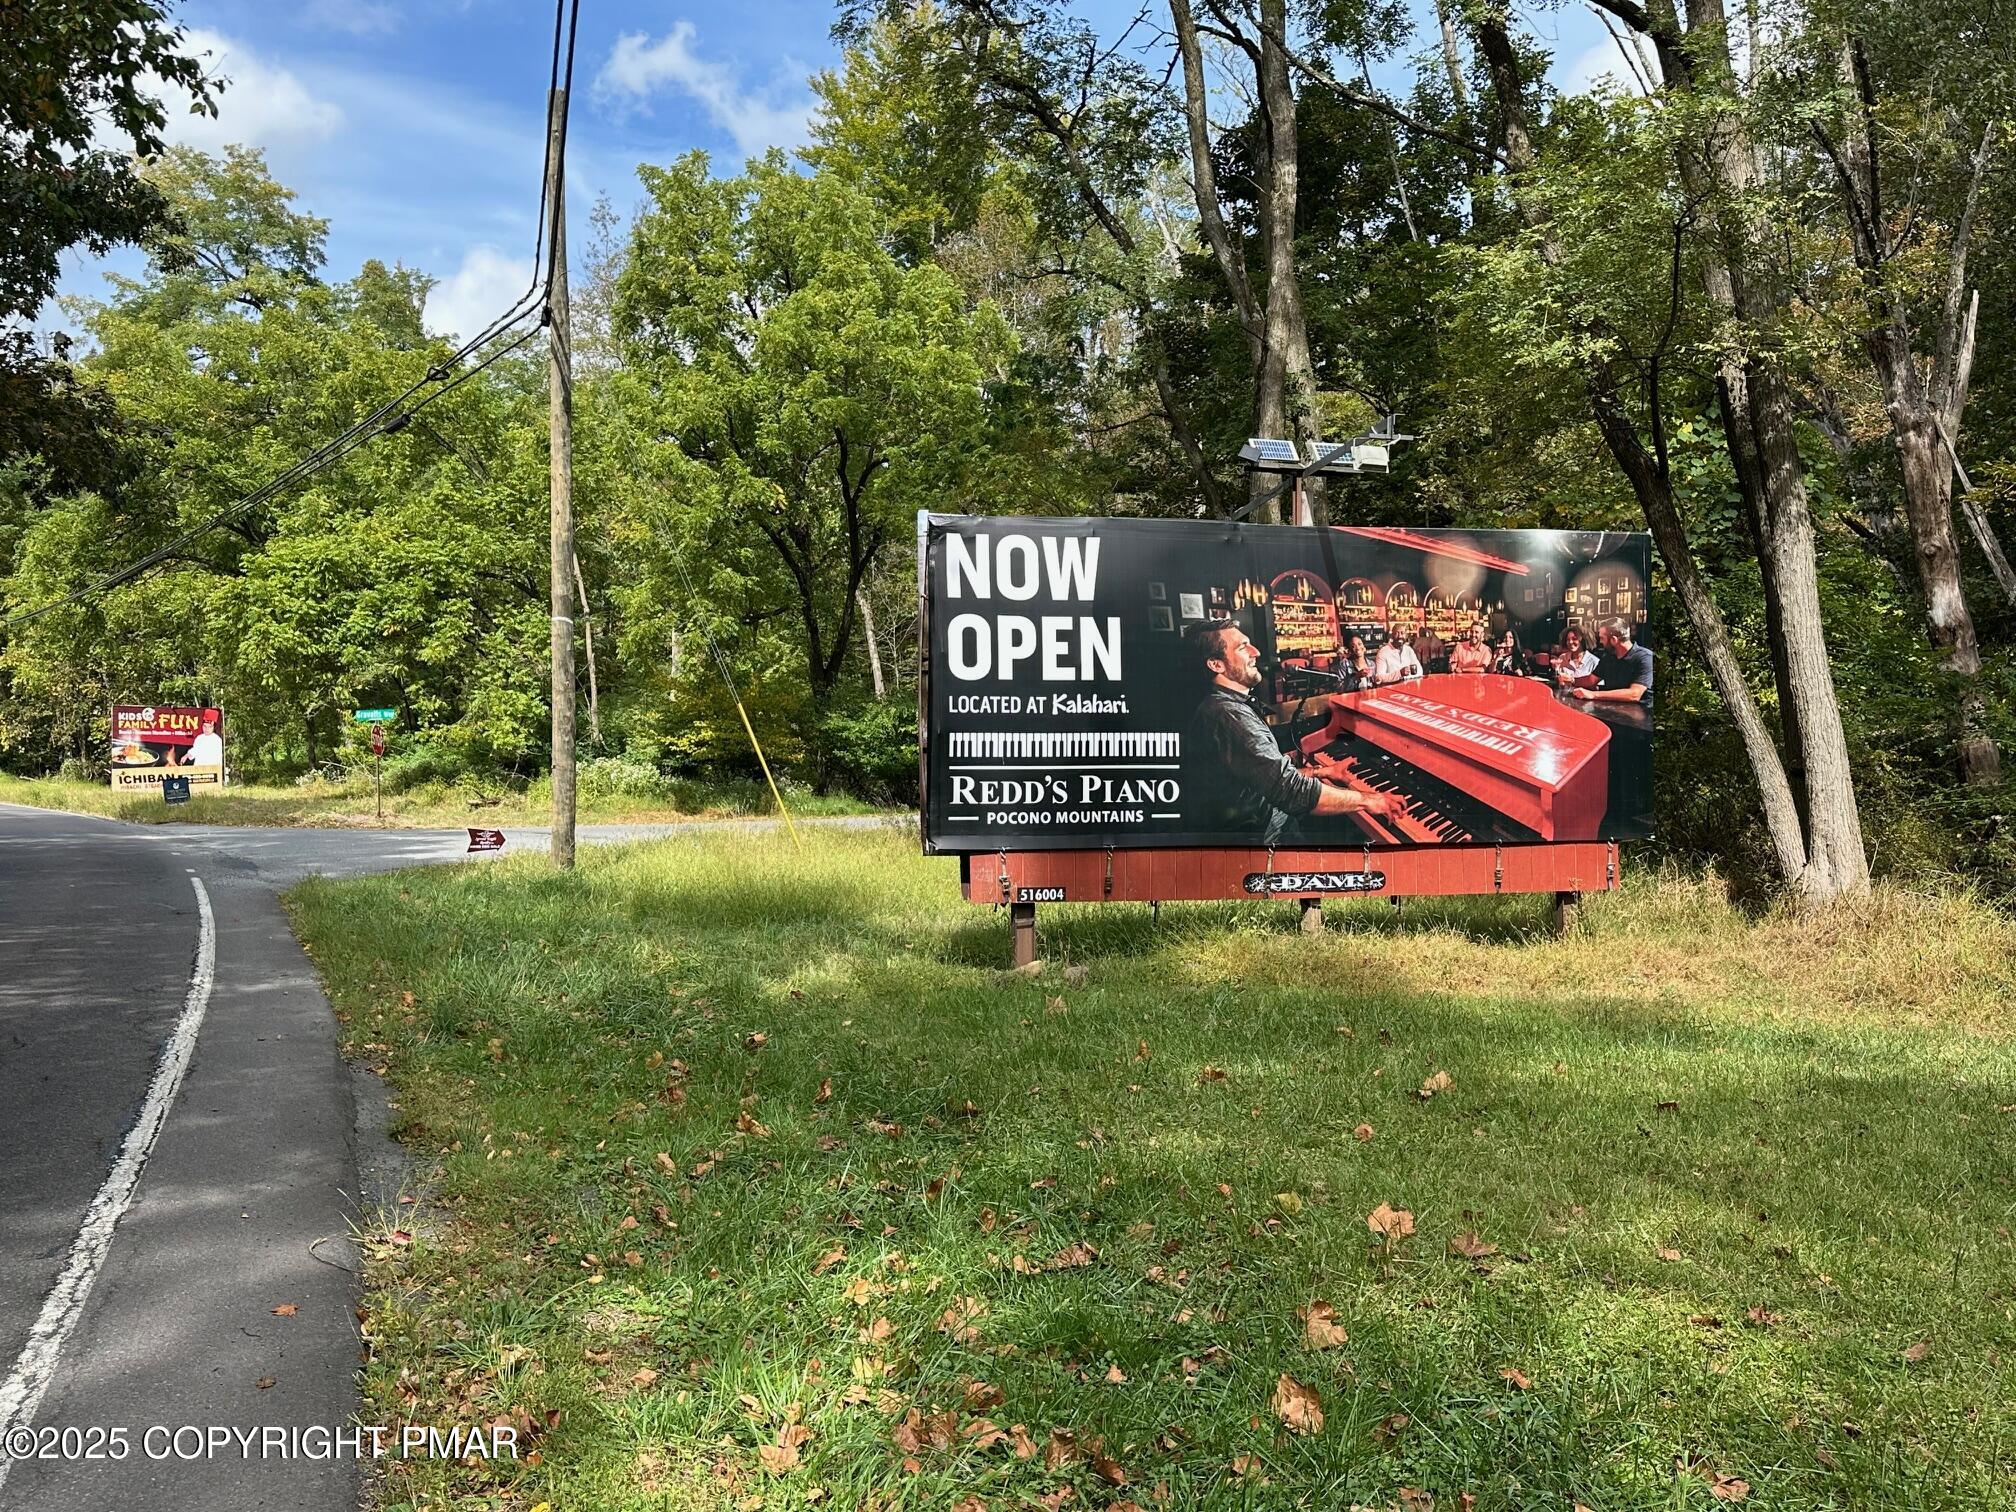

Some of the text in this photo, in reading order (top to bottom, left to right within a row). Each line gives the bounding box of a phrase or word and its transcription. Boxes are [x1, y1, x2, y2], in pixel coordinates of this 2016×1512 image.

[945, 532, 1101, 601] NOW
[947, 613, 1122, 681] OPEN
[949, 695, 1022, 714] LOCATED
[1026, 696, 1047, 714] AT
[118, 712, 142, 721] KIDS
[118, 720, 157, 729] FAMILY
[158, 713, 199, 730] FUN
[949, 775, 1180, 805] REDD'S PIANO
[987, 810, 1144, 824] POCONO MOUNTAINS
[1020, 889, 1064, 901] 516004
